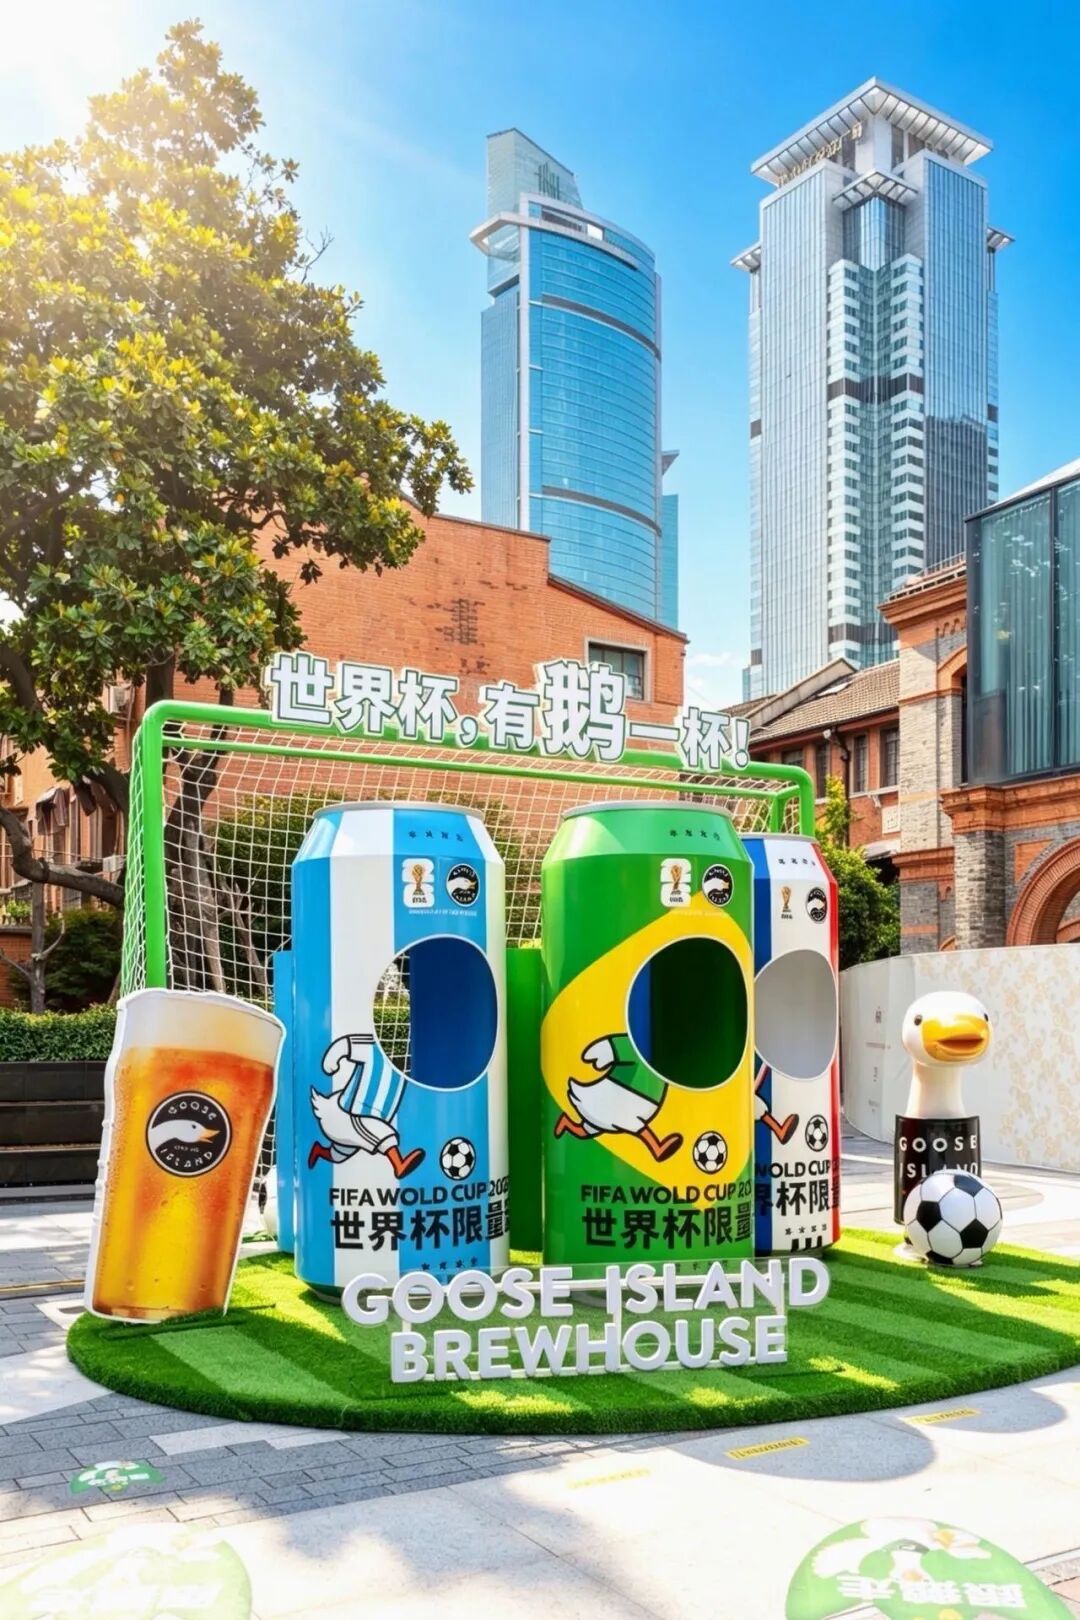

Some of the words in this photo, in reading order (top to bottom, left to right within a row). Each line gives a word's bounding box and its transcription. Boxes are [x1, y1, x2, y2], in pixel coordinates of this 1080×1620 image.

[899, 1134, 978, 1153] GOOSE
[329, 1187, 375, 1207] FIFA
[376, 1186, 448, 1207] WOLD
[451, 1182, 488, 1202] CUP
[580, 1184, 627, 1204] FIFA
[630, 1185, 700, 1205] WOLD
[703, 1181, 737, 1201] CUP
[341, 1266, 573, 1325] GOOSE
[605, 1257, 831, 1315] ISLAND
[390, 1315, 788, 1384] BREWHOUSE
